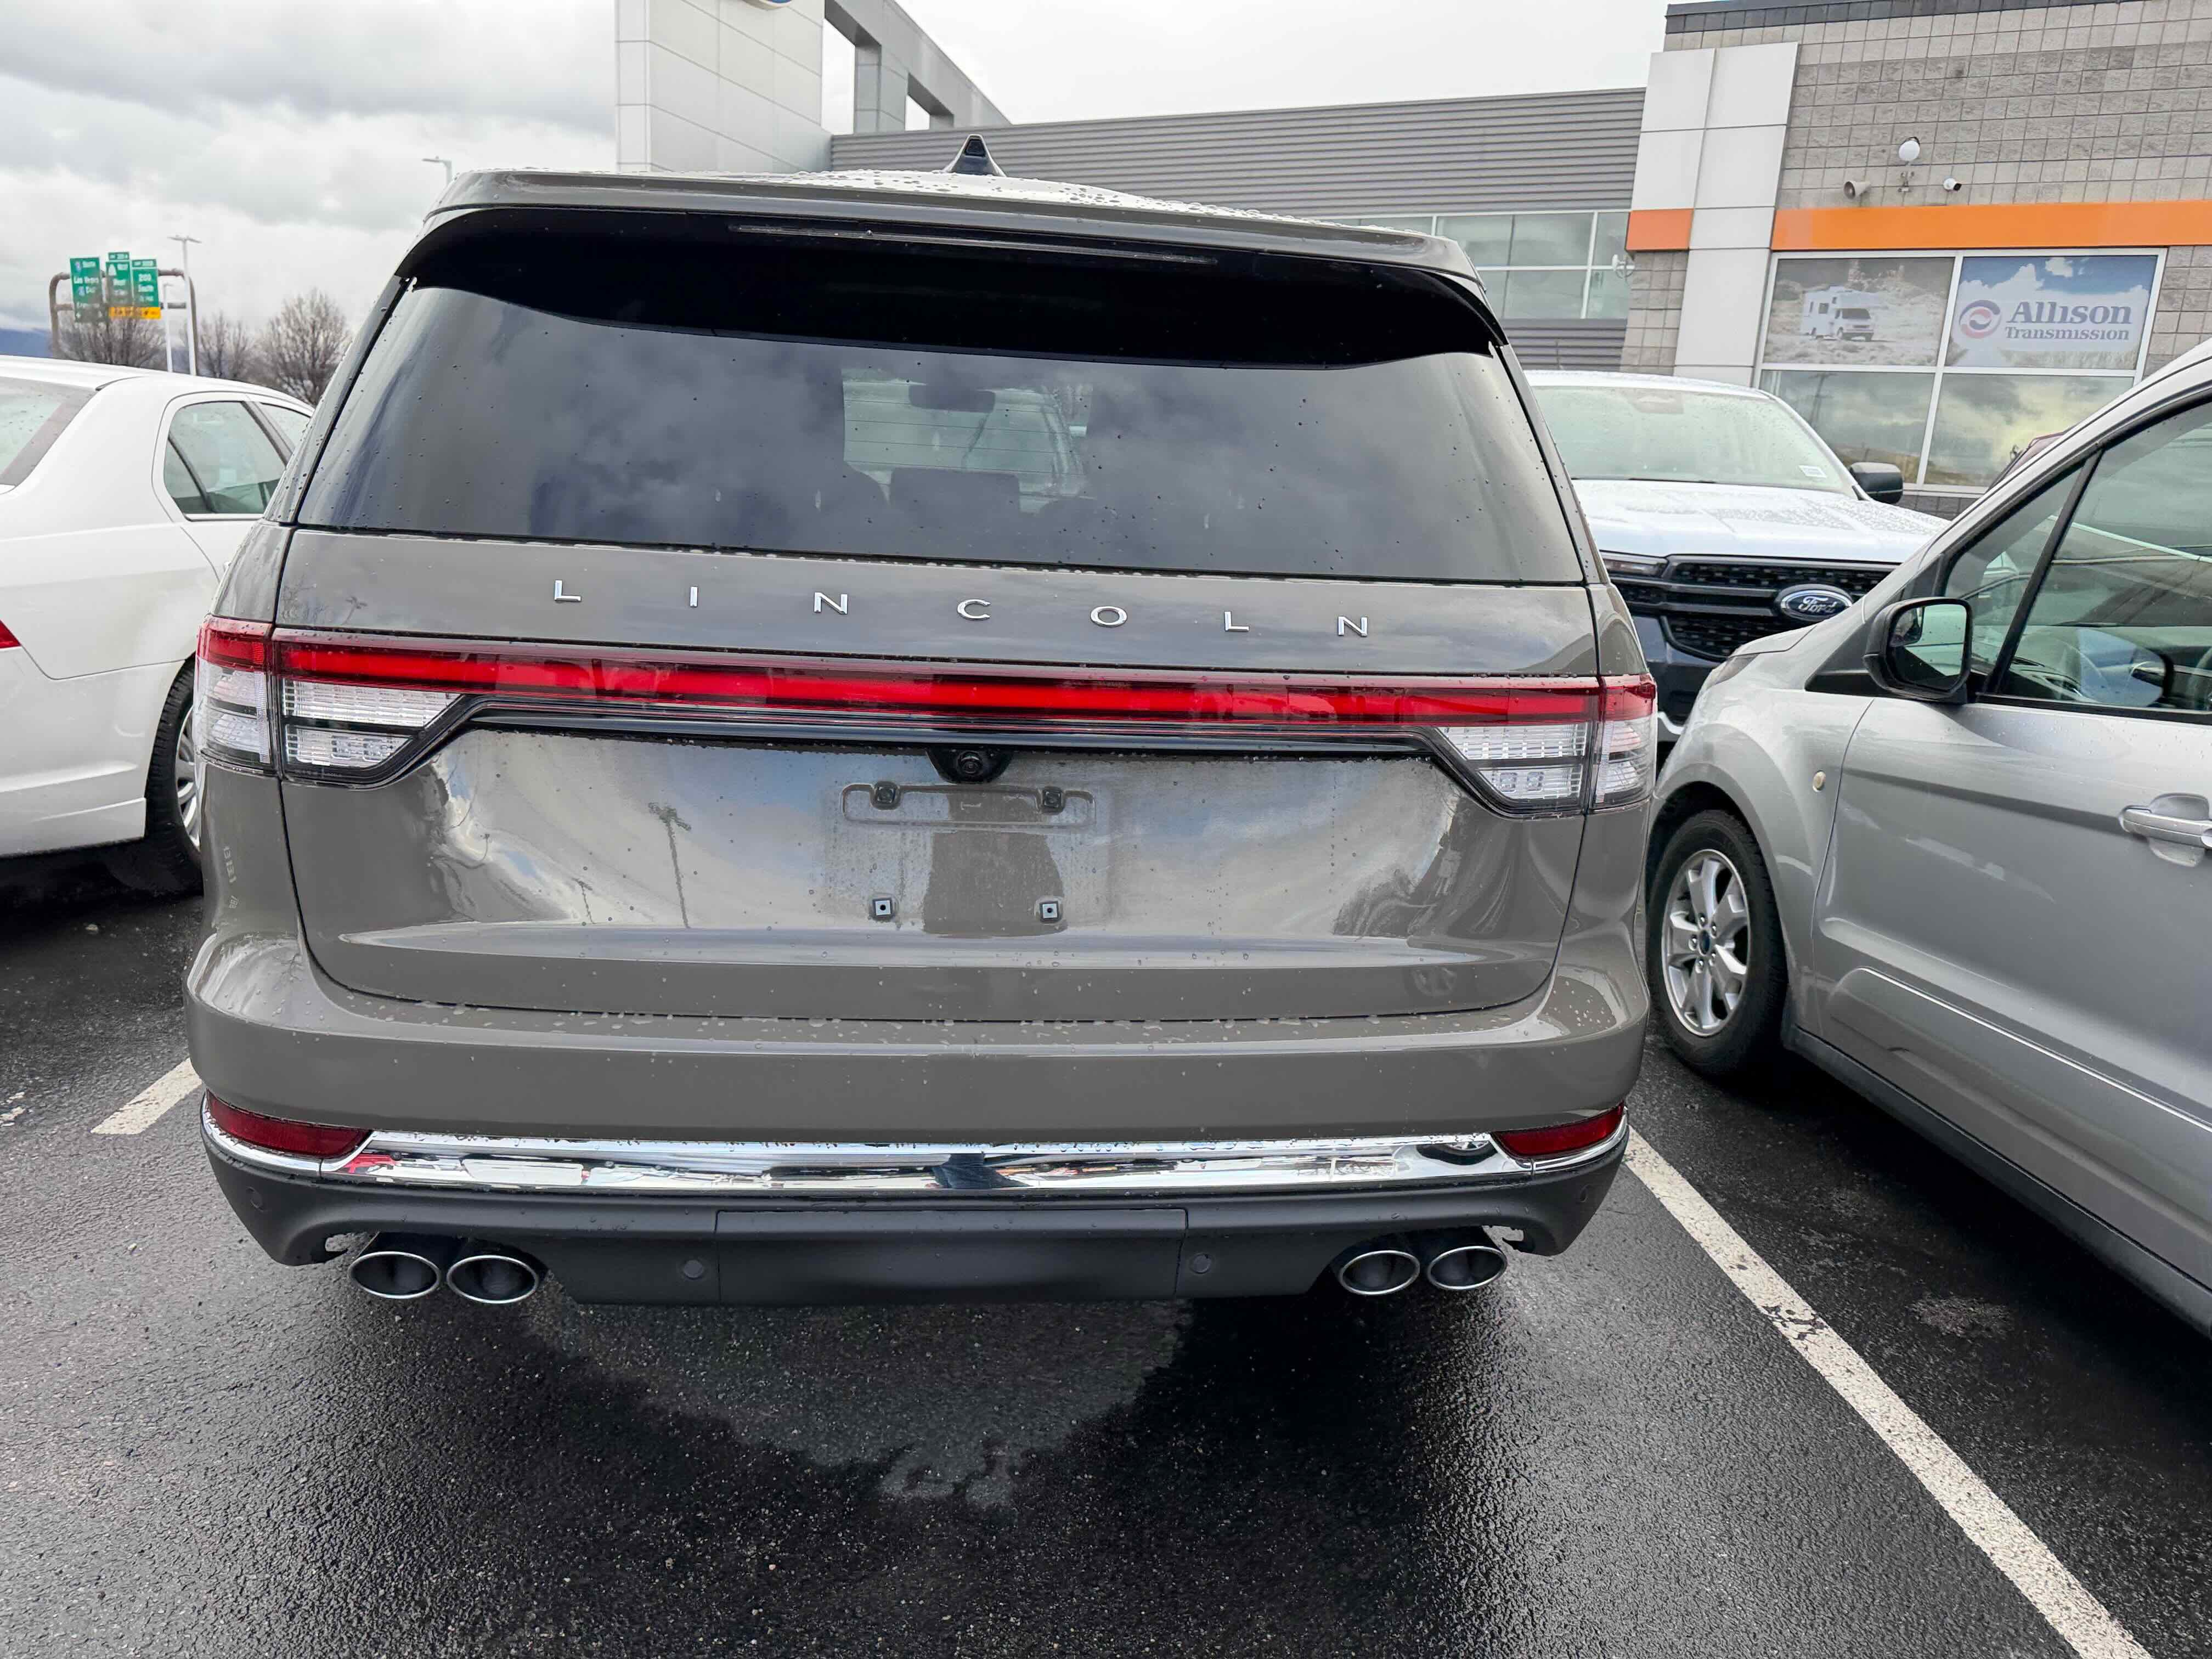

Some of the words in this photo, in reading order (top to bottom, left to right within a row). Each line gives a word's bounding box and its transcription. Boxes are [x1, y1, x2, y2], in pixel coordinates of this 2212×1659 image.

[2006, 301, 2132, 324] Allison
[2005, 326, 2129, 340] Transmission
[554, 579, 1369, 637] LINCOLN
[1798, 595, 1838, 613] Ford
